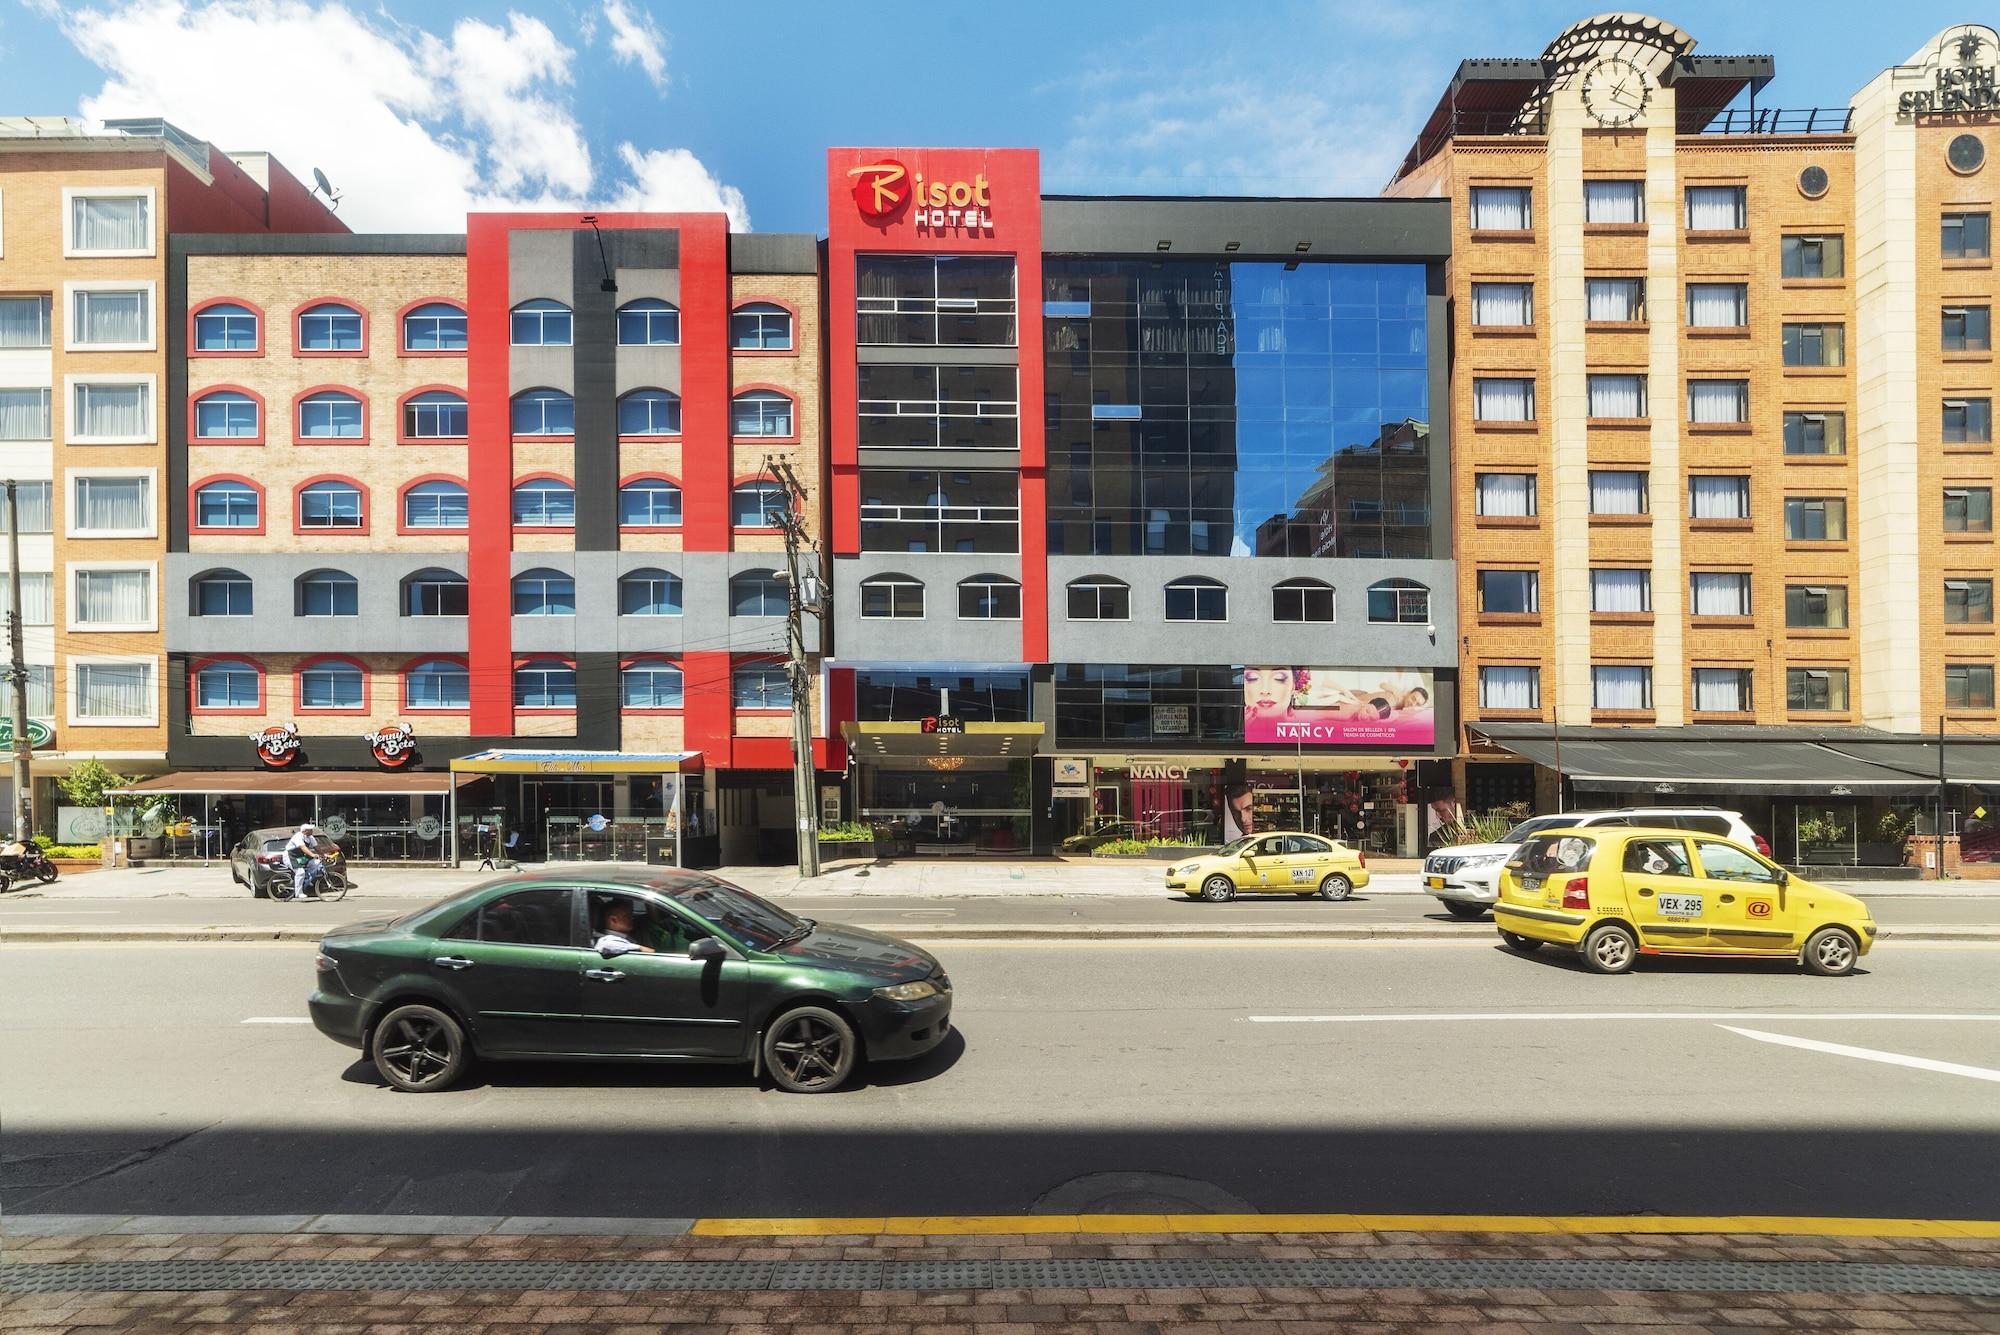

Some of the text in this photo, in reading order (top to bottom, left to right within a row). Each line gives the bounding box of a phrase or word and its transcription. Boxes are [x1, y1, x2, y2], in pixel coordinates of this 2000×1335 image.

[1899, 88, 2000, 111] SPLEND
[847, 165, 990, 213] Risot
[914, 210, 993, 228] HOTEL
[920, 717, 960, 732] Risot
[1276, 726, 1335, 738] NANCY
[249, 731, 289, 747] Yenny
[269, 739, 301, 755] Beto
[364, 731, 404, 747] Yenny
[384, 739, 415, 755] Beto
[1130, 765, 1190, 779] NANCY
[1748, 901, 1770, 916] @
